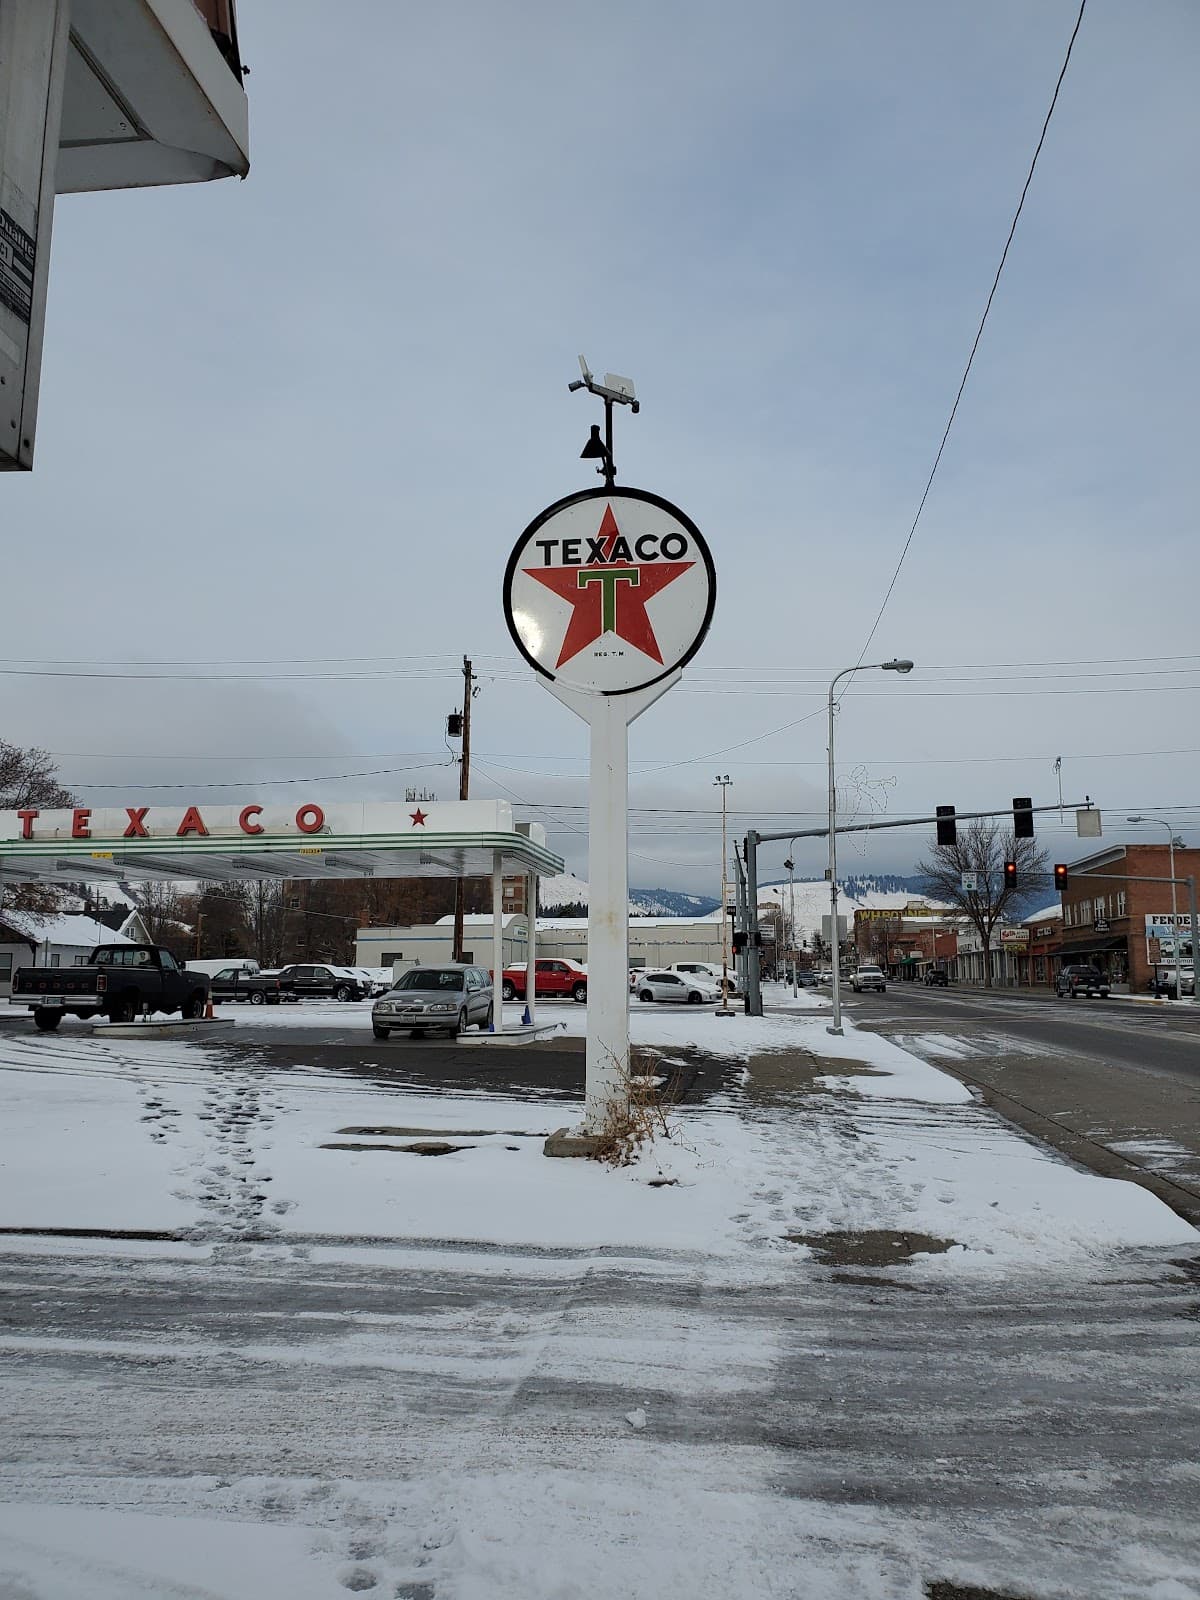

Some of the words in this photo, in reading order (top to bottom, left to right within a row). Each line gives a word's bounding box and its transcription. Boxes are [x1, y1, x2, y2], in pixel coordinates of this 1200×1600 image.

[536, 532, 689, 566] TEXACO
[577, 567, 641, 634] T
[17, 803, 325, 839] TEXACO
[1152, 915, 1199, 925] FENDE
